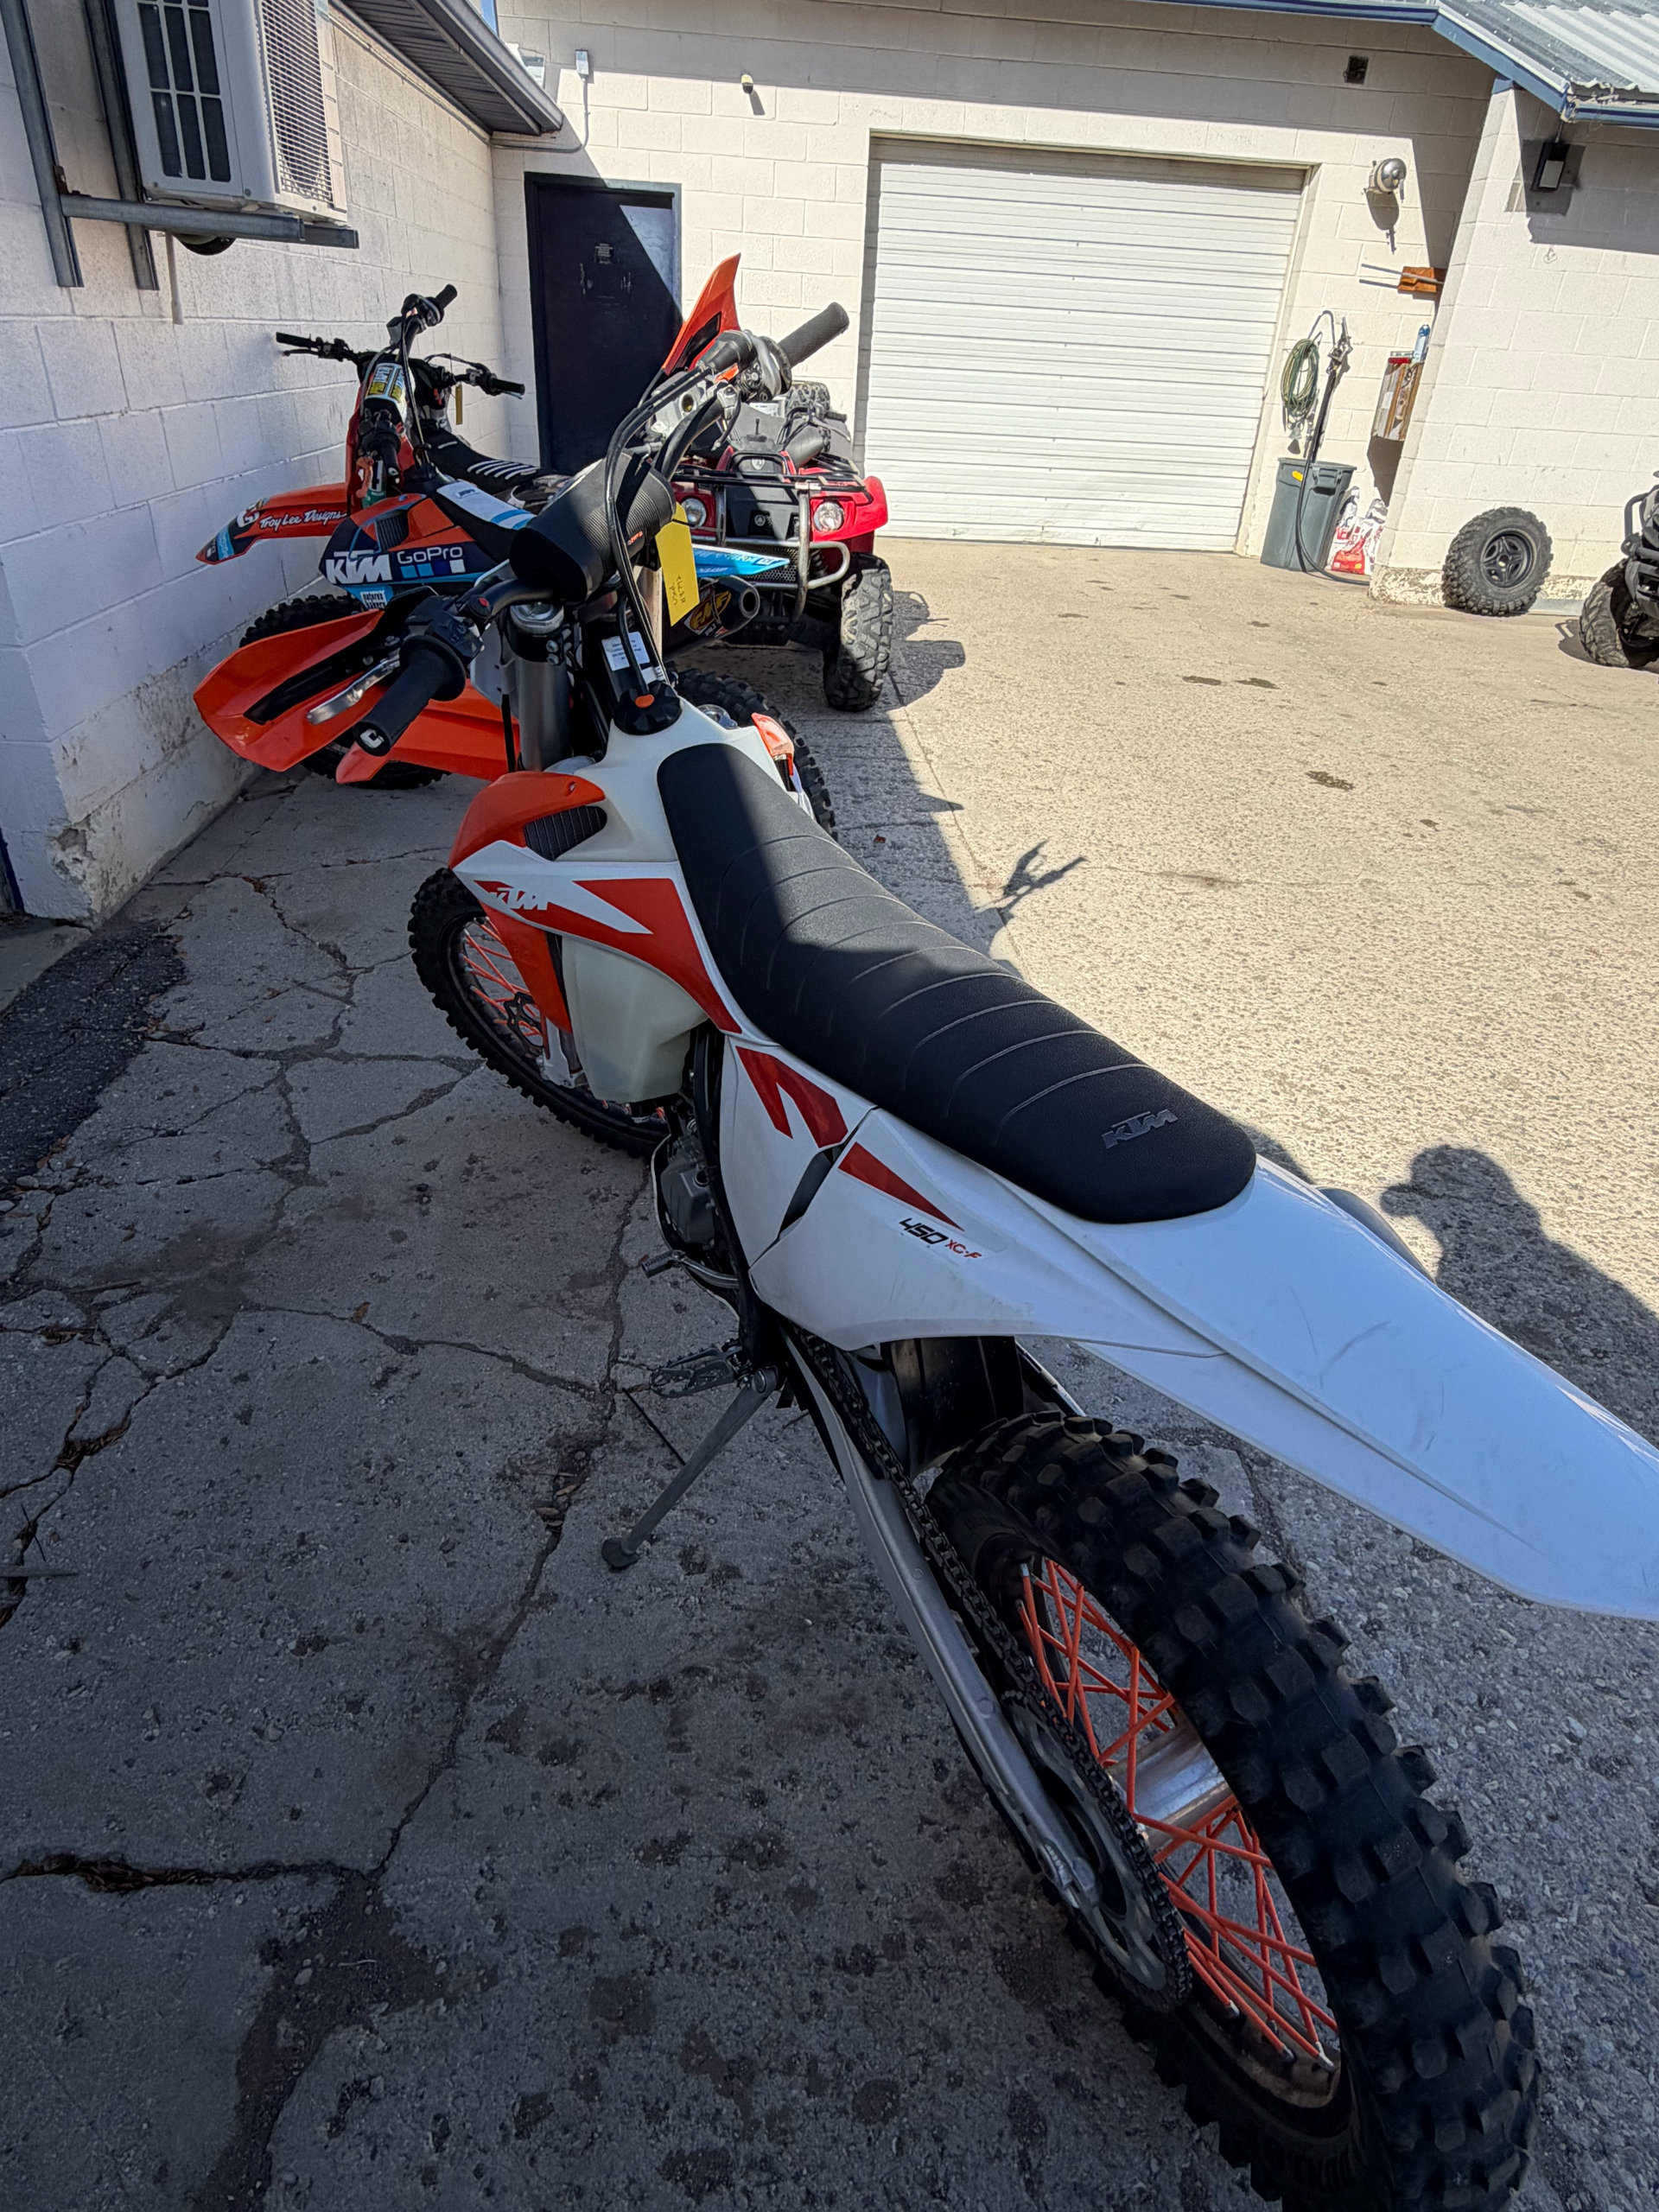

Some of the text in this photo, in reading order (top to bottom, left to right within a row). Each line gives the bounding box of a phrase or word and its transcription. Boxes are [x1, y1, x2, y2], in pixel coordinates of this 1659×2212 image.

[259, 509, 347, 531] Troy Lee Designs
[325, 550, 393, 585] KTM
[397, 546, 463, 564] GoPro
[690, 590, 732, 630] FMF
[488, 887, 548, 911] KTM
[1102, 1109, 1179, 1149] KTM
[899, 1217, 982, 1258] 450 XC-F
